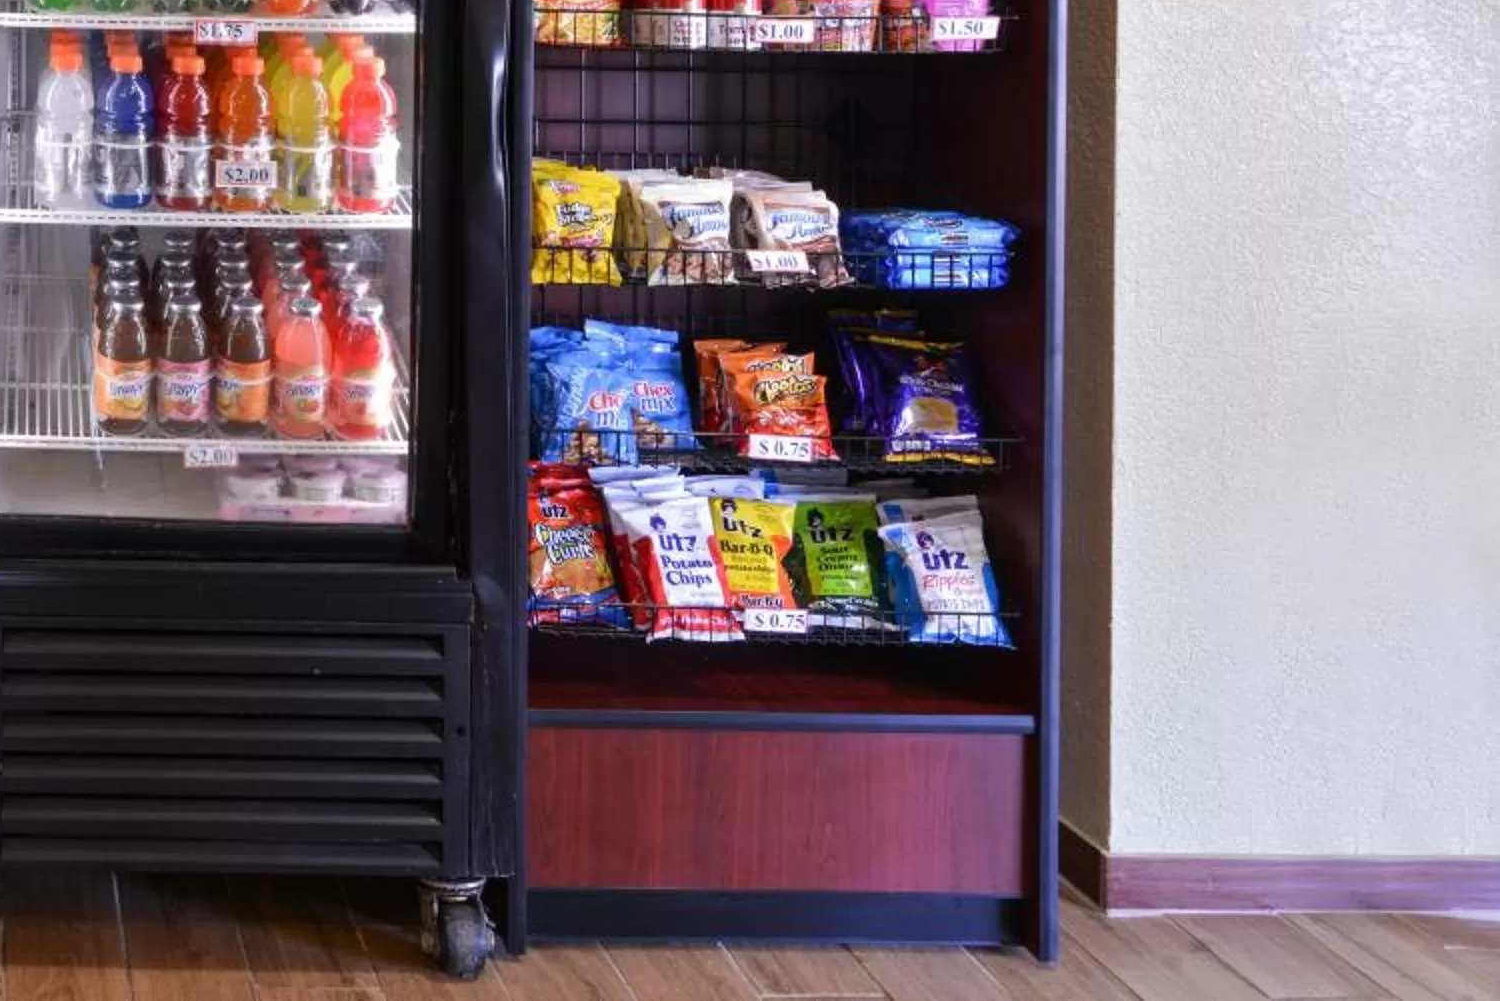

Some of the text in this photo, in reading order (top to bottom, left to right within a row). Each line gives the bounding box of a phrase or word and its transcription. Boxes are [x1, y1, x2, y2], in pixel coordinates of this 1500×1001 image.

[758, 23, 804, 39] $1.00
[938, 20, 984, 36] $1.50
[224, 167, 269, 183] $2.00
[633, 381, 674, 397] Chex
[666, 570, 713, 589] Chips
